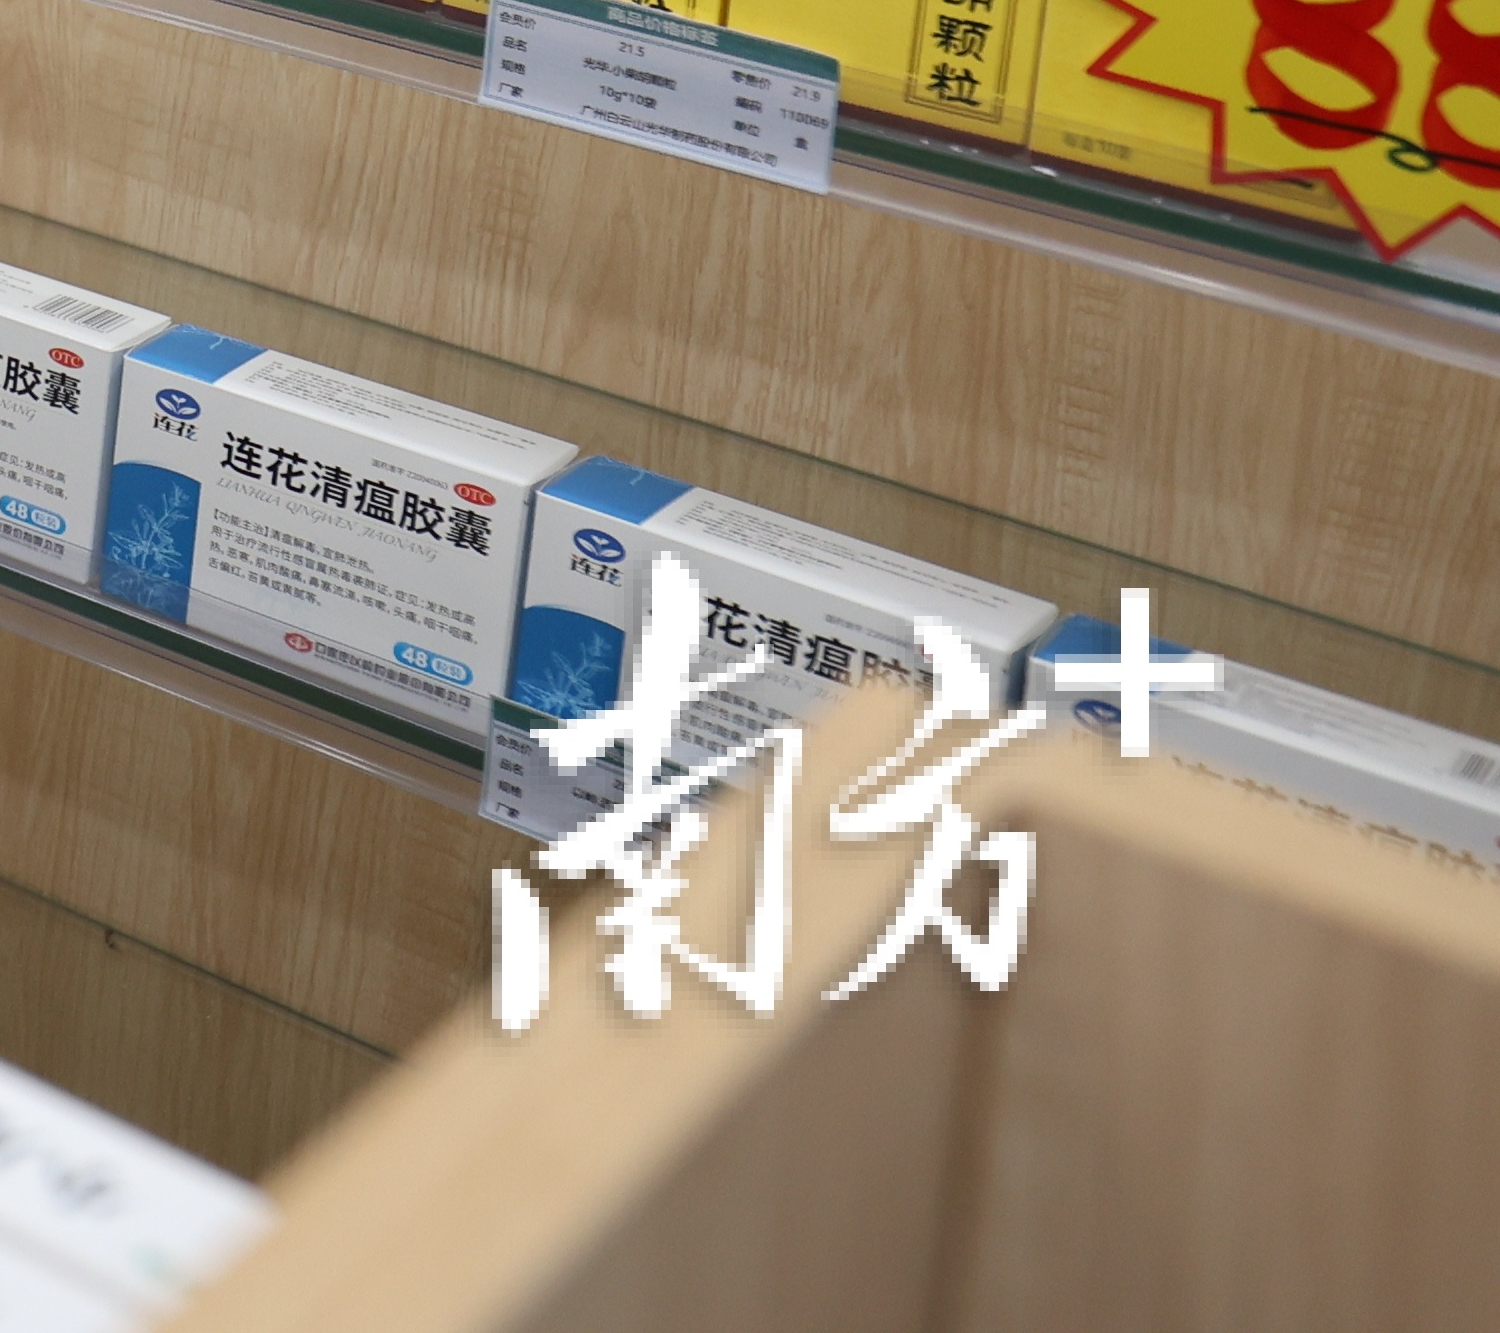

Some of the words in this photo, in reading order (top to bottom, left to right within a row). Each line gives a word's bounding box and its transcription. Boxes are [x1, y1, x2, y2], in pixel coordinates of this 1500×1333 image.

[607, 5, 719, 48] 商品价格标签
[502, 36, 528, 53] 品名
[618, 41, 645, 58] 21.5
[731, 70, 772, 91] 零售价
[51, 349, 82, 368] OTC
[153, 412, 199, 442] 连花
[220, 431, 493, 557] 连花清瘟胶囊
[457, 484, 493, 506] OTC
[5, 499, 29, 519] 48
[217, 476, 282, 507] LIANHUA
[285, 496, 356, 532] QINGWEN
[357, 525, 437, 563] JIAONANG
[570, 554, 625, 588] 连花
[402, 647, 429, 669] 48
[703, 596, 941, 699] 花清瘟胶
